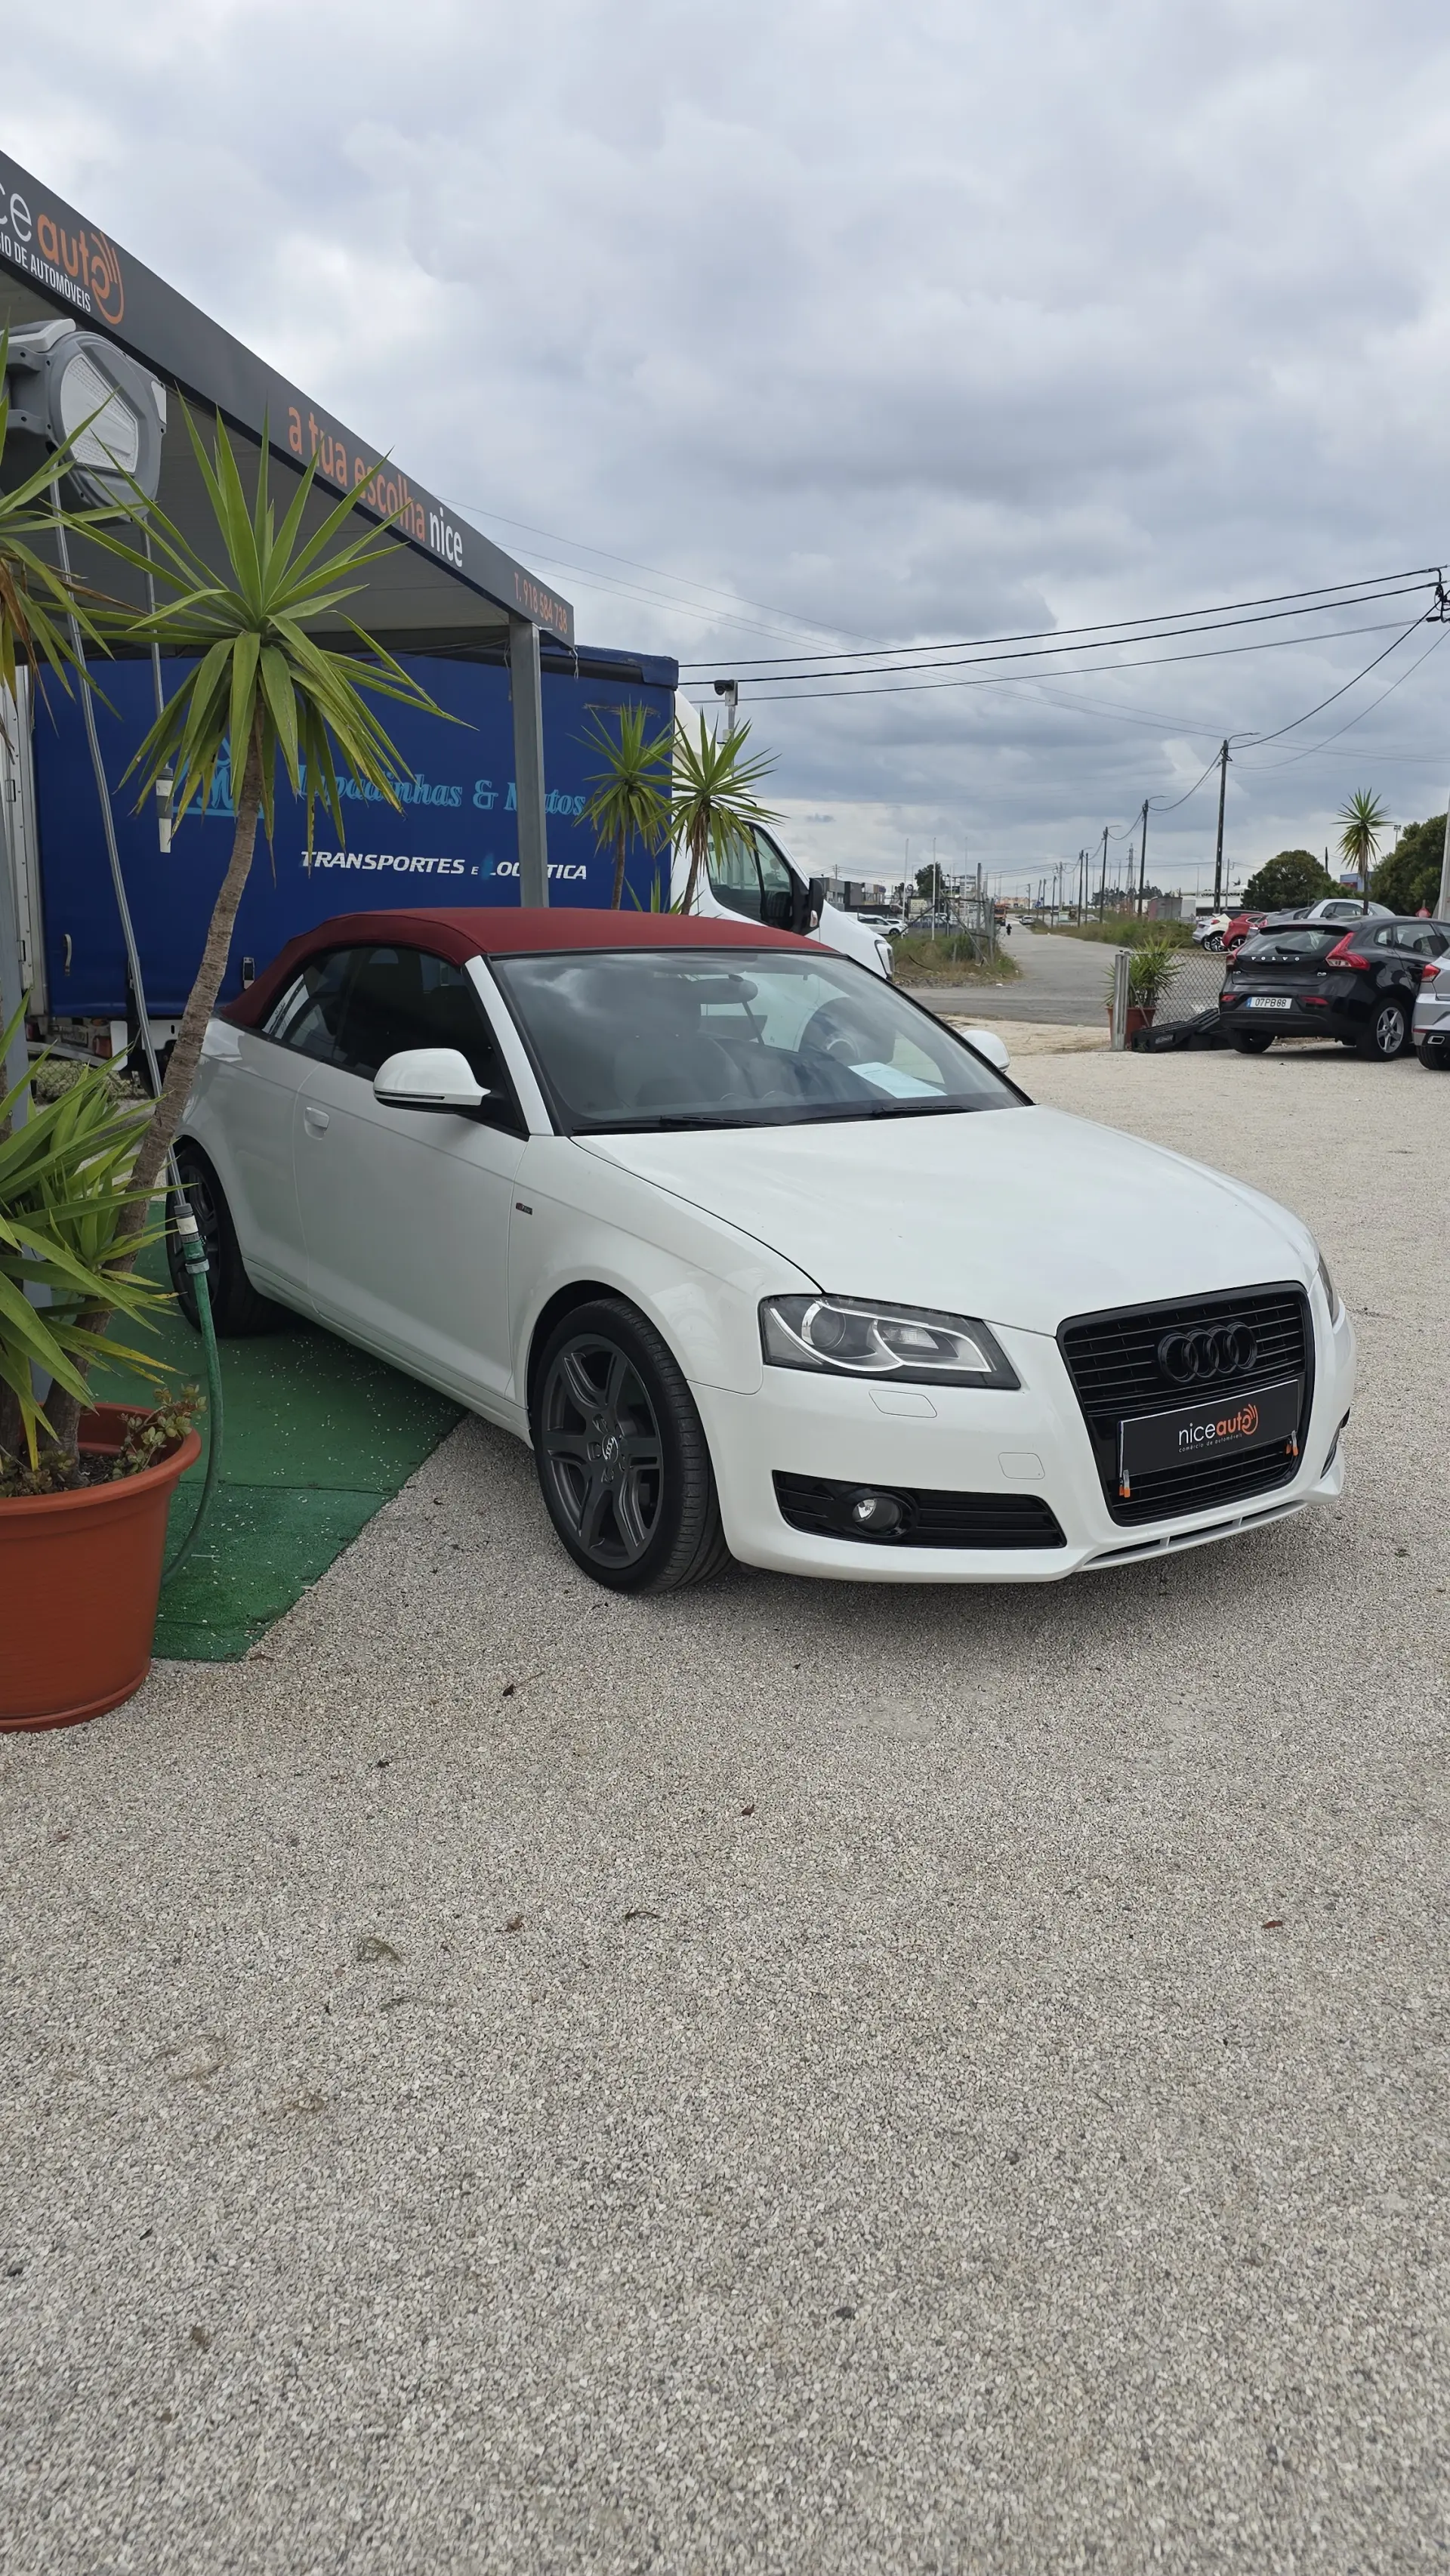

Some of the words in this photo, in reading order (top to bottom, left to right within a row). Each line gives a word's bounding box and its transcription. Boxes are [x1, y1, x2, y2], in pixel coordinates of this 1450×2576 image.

[0, 232, 11, 257] IO
[14, 241, 28, 269] DE
[288, 406, 302, 455] a
[308, 412, 347, 486] tua
[354, 457, 425, 542] escolha
[430, 507, 463, 567] nice
[523, 579, 538, 613] 918
[540, 591, 553, 624] 584
[554, 602, 568, 634] 738
[473, 779, 498, 810] &
[301, 851, 465, 874] TRANSPORTES
[1178, 1404, 1258, 1446] niceauto
